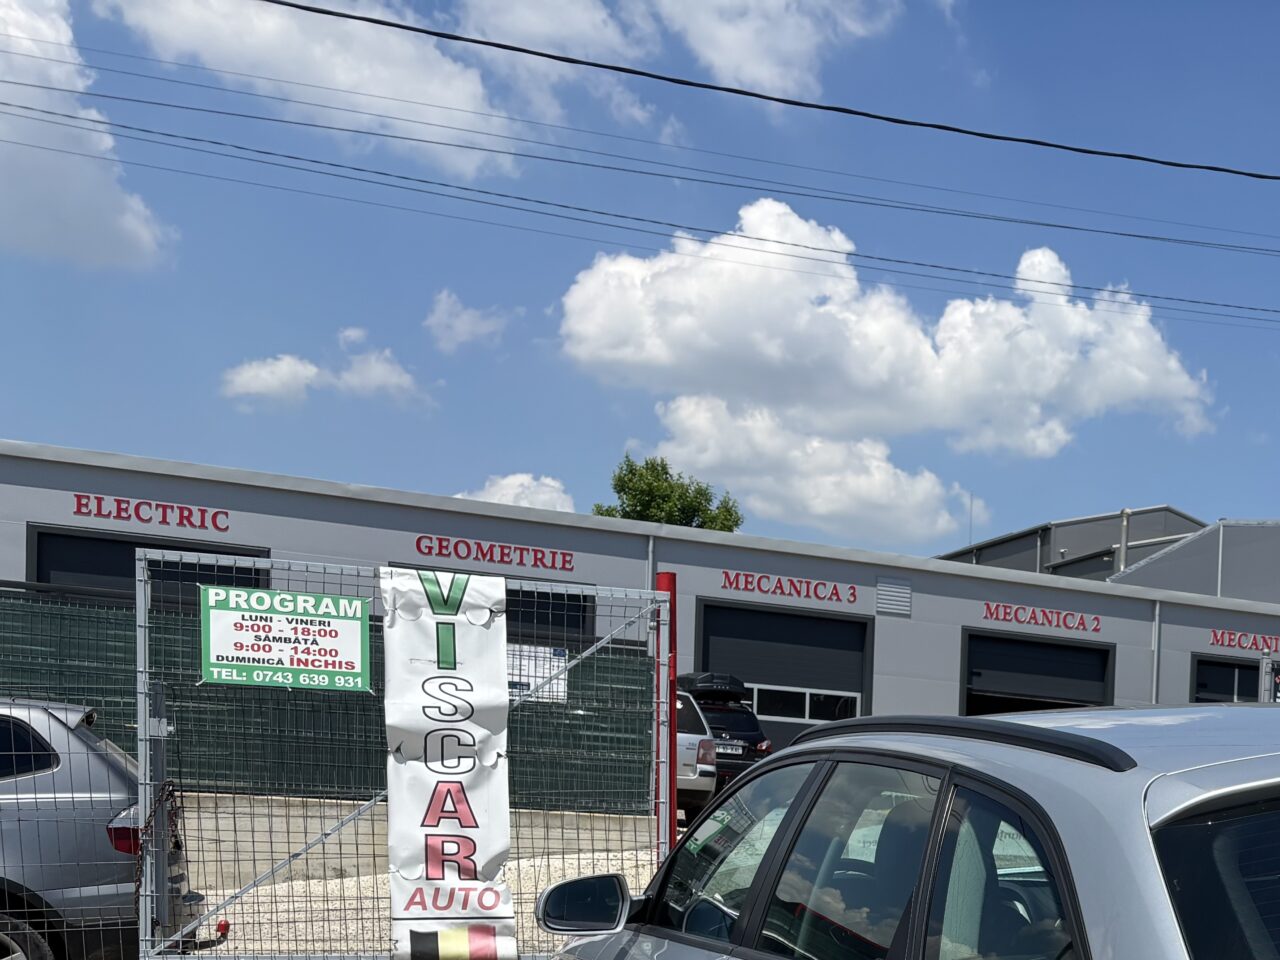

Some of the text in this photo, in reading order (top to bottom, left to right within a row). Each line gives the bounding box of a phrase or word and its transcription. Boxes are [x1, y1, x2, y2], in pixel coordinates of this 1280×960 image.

[73, 494, 230, 532] ELECTRIC
[415, 535, 575, 572] GEOMETRIE
[721, 570, 857, 604] MECANICA 3
[208, 588, 362, 618] PROGRAM
[233, 622, 272, 634] 9:00
[290, 626, 339, 638] 18:00
[241, 614, 273, 623] LUNI
[285, 617, 331, 627] VINERI
[983, 602, 1102, 633] MECANICA 2
[215, 654, 356, 670] DUMINICĂ ÎNCHIS
[233, 642, 272, 653] 9:00
[290, 646, 339, 658] 14:00
[209, 667, 362, 688] TEL: 0743 639 931
[417, 570, 480, 881] VISCAR
[404, 887, 502, 912] AUTO
